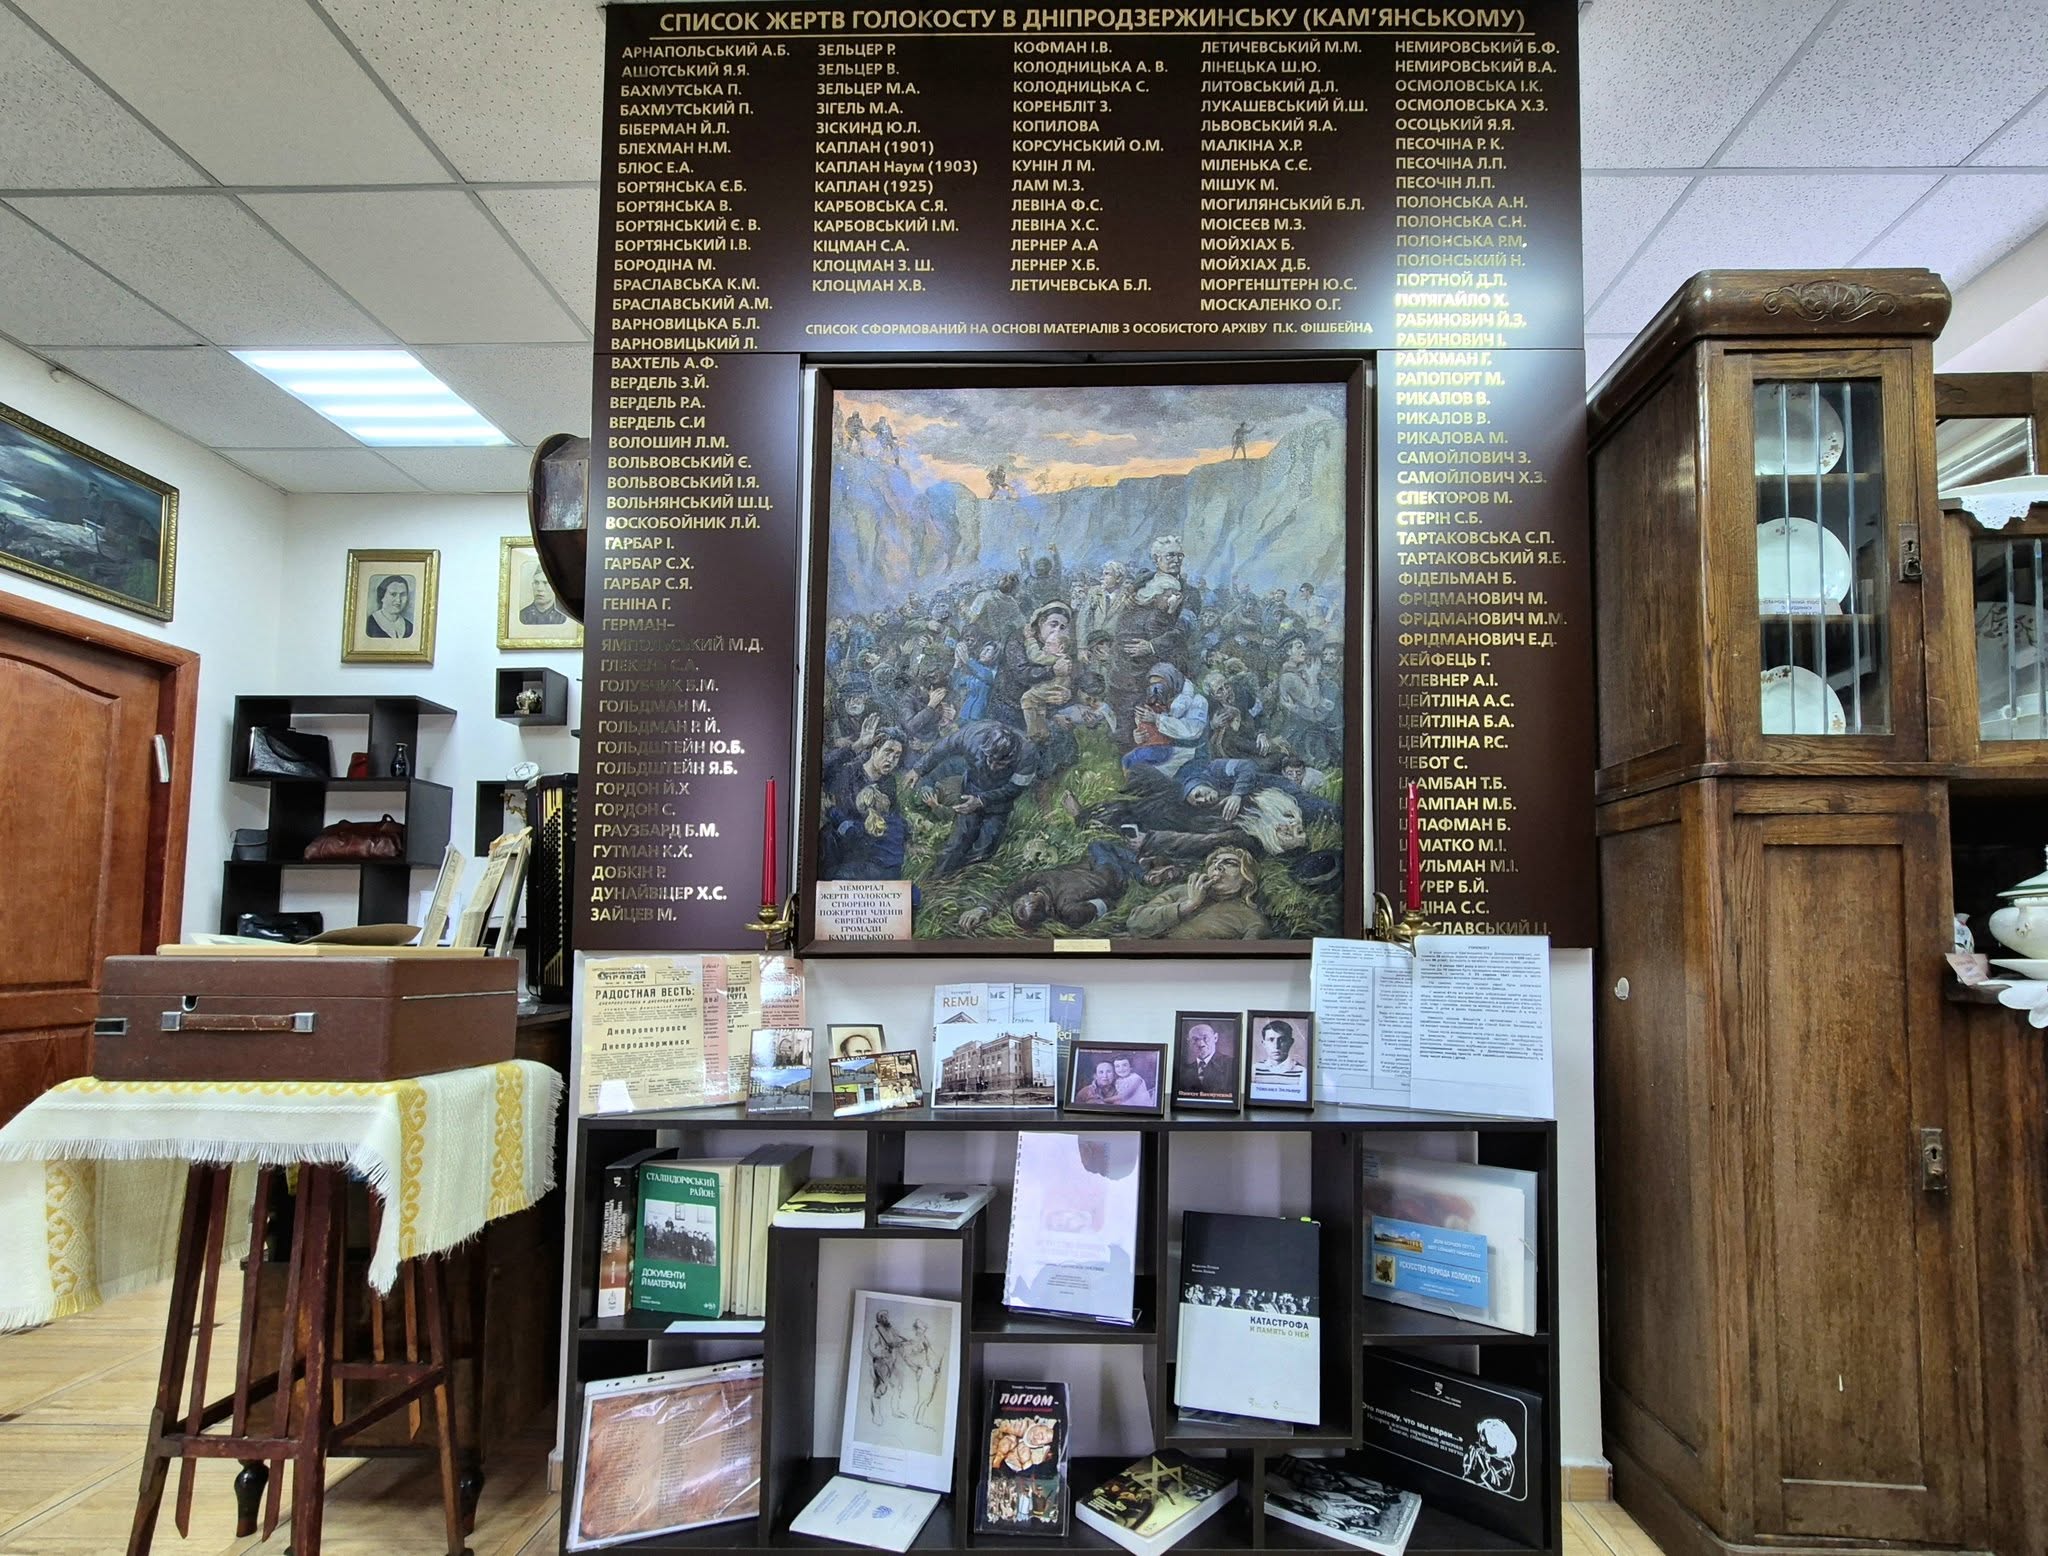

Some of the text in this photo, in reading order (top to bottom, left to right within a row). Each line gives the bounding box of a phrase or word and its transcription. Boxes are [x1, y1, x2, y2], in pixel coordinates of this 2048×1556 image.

[660, 12, 759, 31] СПИСОК
[766, 11, 845, 30] ЖЕРТВ
[853, 9, 996, 29] ГОЛОКОСТУ
[1003, 9, 1016, 27] В
[1023, 8, 1297, 31] ДНІПРОДЗЕРЖИНСЬКУ
[622, 42, 790, 58] АРНАПОЛЬСЬКИЙ А.Б.
[1014, 41, 1112, 54] КОФМАН І.В.
[1201, 38, 1362, 53] ЛЕТИЧЕВСЬКИЙ М.М.
[1395, 39, 1559, 54] НЕМИРОВСЬКИЙ Б.Ф.
[622, 62, 749, 77] АШОТСЬКИЙ Я.Я.
[621, 84, 742, 97] БАХМУТСЬКА П.
[817, 82, 920, 96] ЗЕЛЬЦЕР М.А.
[1014, 81, 1149, 95] КОЛОДНИЦЬКА С.
[816, 102, 903, 114] ЗІГЕЛЬ М.А.
[1201, 97, 1368, 112] ЛУКАШЕВСЬКИЙ Й.Ш.
[1395, 99, 1548, 111] ОСМОЛОВСЬКА Х.З.
[816, 121, 920, 136] ЗІСКИНД Ю.Л.
[1013, 120, 1100, 132] КОПИЛОВА
[1395, 115, 1515, 133] ОСОЦЬКИЙ Я.Я.
[619, 141, 731, 155] БЛЕХМАН Н.М.
[816, 141, 934, 156] КАПЛАН (1901)
[1013, 137, 1164, 152] КОРСУНСЬКИЙ О.М.
[1201, 139, 1302, 151] МАЛКІНА Х.Р.
[1396, 137, 1504, 150] ПЕСОЧІНА Р. К.
[618, 161, 694, 174] БЛЮС Е.А.
[816, 160, 977, 176] КАПЛАН Наум (1903)
[1011, 179, 1084, 192] ЛАМ М.З.
[1201, 178, 1279, 191] МІШУК М.
[814, 200, 947, 213] КАРБОВСЬКА С.Я.
[1011, 198, 1103, 211] ЛЕВІНА Ф.С.
[616, 216, 761, 232] БОРТЯНСЬКИЙ Є. В.
[814, 239, 909, 254] КІЦМАН С.А.
[614, 258, 716, 273] БОРОДІНА М.
[1010, 259, 1099, 271] ЛЕРНЕР Х.Б.
[1201, 255, 1310, 272] МОЙХІАХ Д.Б.
[614, 278, 760, 291] БРАСЛАВСЬКА К.М.
[1201, 298, 1340, 311] МОСКАЛЕНКО О.Г.
[806, 320, 1373, 334] СПИСОК СФОРМОВАНИЙ НА ОСНОВІ МАТЕРІАЛІВ З ОСОБИСТОГО АРХІВУ П.К. ФІШБЕЙНА
[612, 356, 718, 369] ВАХТЕЛЬ А.Ф.
[611, 376, 709, 391] ВЕРДЕЛЬ З.Й.
[609, 436, 729, 448] ВОЛОШИН Л.М.
[1397, 449, 1531, 464] САМОЙЛОВИЧ З.
[608, 474, 759, 488] ВОЛЬВОВСЬКИЙ І.Я.
[1397, 531, 1554, 544] ТАРТАКОВСЬКА С.П.
[605, 557, 694, 570] ГАРБАР С.Х.
[1399, 572, 1516, 586] ФІДЕЛЬМАН Б.
[1399, 651, 1490, 668] ХЕЙФЕЦЬ Г.
[1399, 733, 1508, 751] ЦЕЙТЛІНА Р.С.
[595, 987, 695, 1000] РАДОСТНАЯ ВЕСТЬ:
[943, 996, 979, 1007] REMU
[607, 1025, 686, 1036] Днепропетровск
[602, 1039, 690, 1051] Днепродзержинск
[689, 1188, 715, 1198] РАЙОН:
[642, 1268, 686, 1279] ДОКУМЕНТИ
[1399, 1261, 1426, 1273] ИСКУССТВО
[1428, 1266, 1450, 1278] ПЕРИОДА
[1451, 1272, 1480, 1284] ХОЛОКОСТА
[641, 1278, 686, 1289] Й МАТЕРІАЛИ
[1250, 1316, 1309, 1330] КАТАСТРОФА
[1256, 1326, 1286, 1336] ПАМЯТЬ
[1288, 1328, 1293, 1336] О
[1375, 1407, 1402, 1422] потому,
[1403, 1417, 1415, 1425] что
[1417, 1422, 1429, 1430] мы
